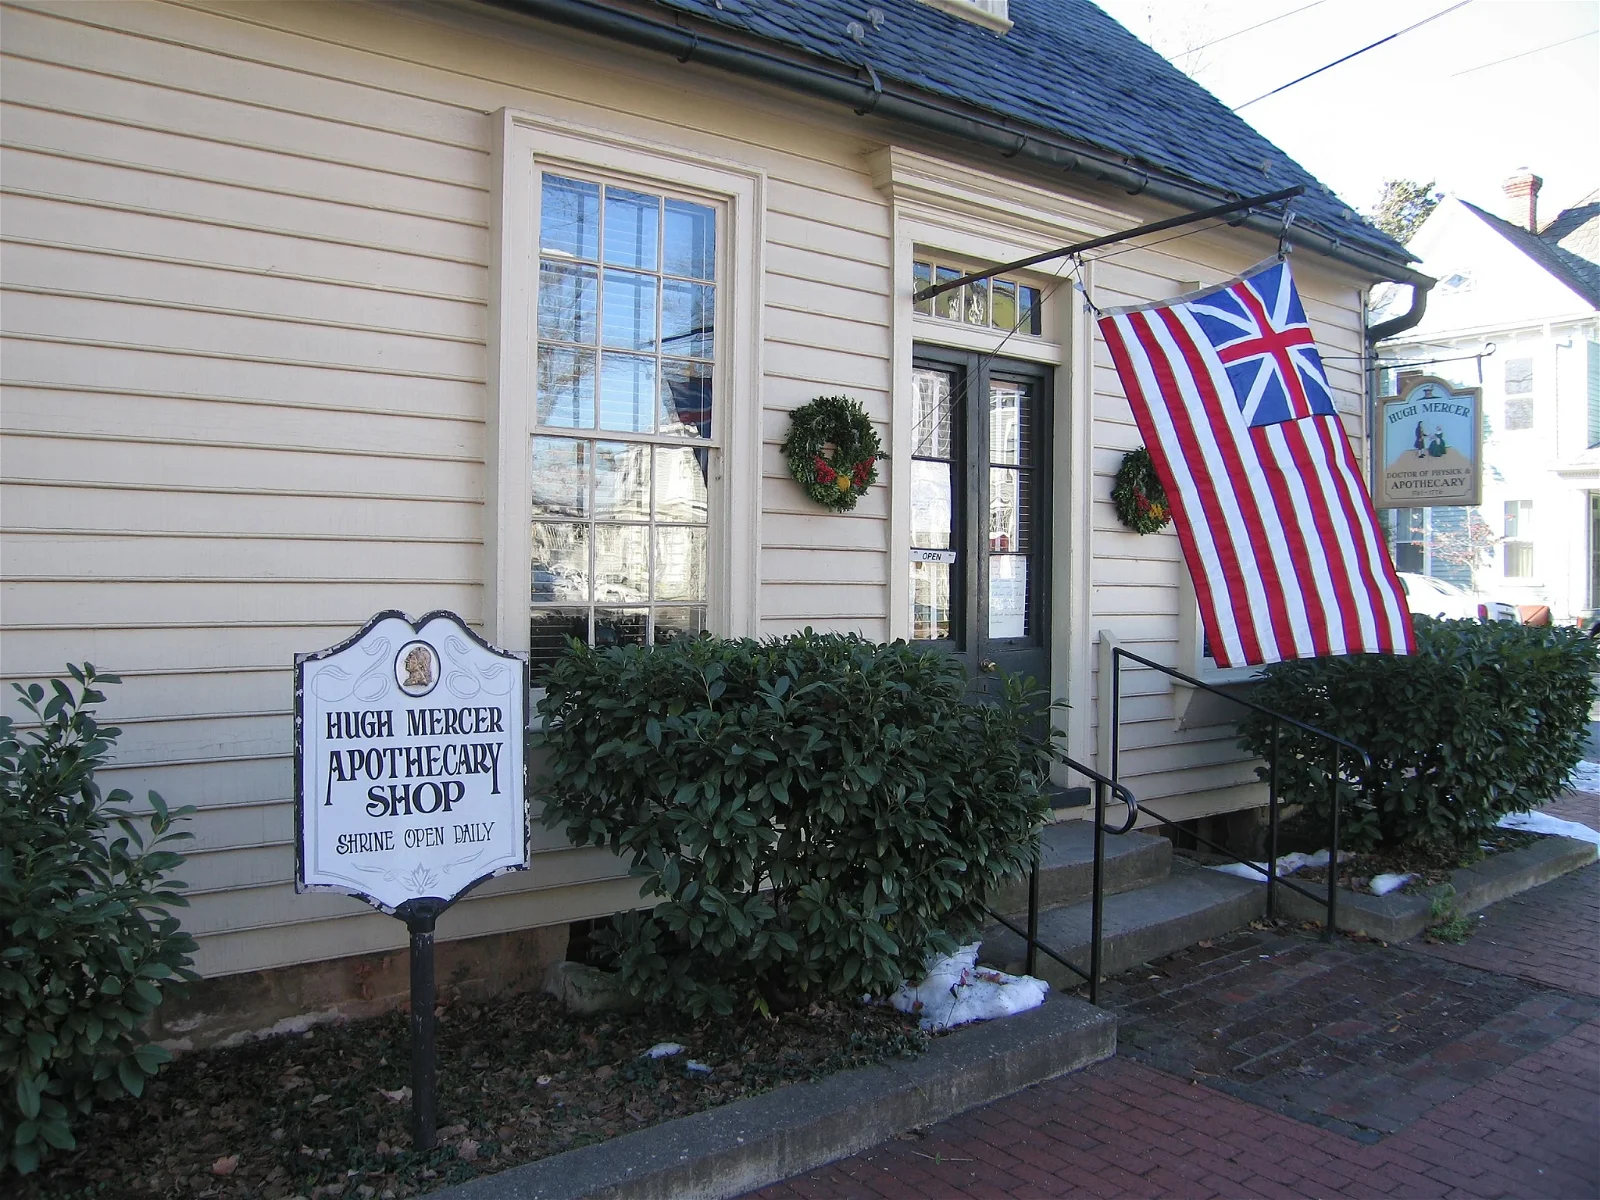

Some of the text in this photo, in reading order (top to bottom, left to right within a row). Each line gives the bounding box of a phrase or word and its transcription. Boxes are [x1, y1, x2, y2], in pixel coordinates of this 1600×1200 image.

[1388, 402, 1470, 423] HUGH MERCER
[1386, 471, 1418, 479] DOCTOR
[1432, 468, 1463, 476] PHYSICK
[1391, 477, 1465, 489] APOTHECARY
[922, 552, 941, 560] OPEN
[326, 706, 505, 740] HUGH MERCER
[324, 742, 504, 807] APOTHECARY
[365, 780, 466, 818] SHOP
[336, 821, 496, 855] SHRINE OPEN DAILY
